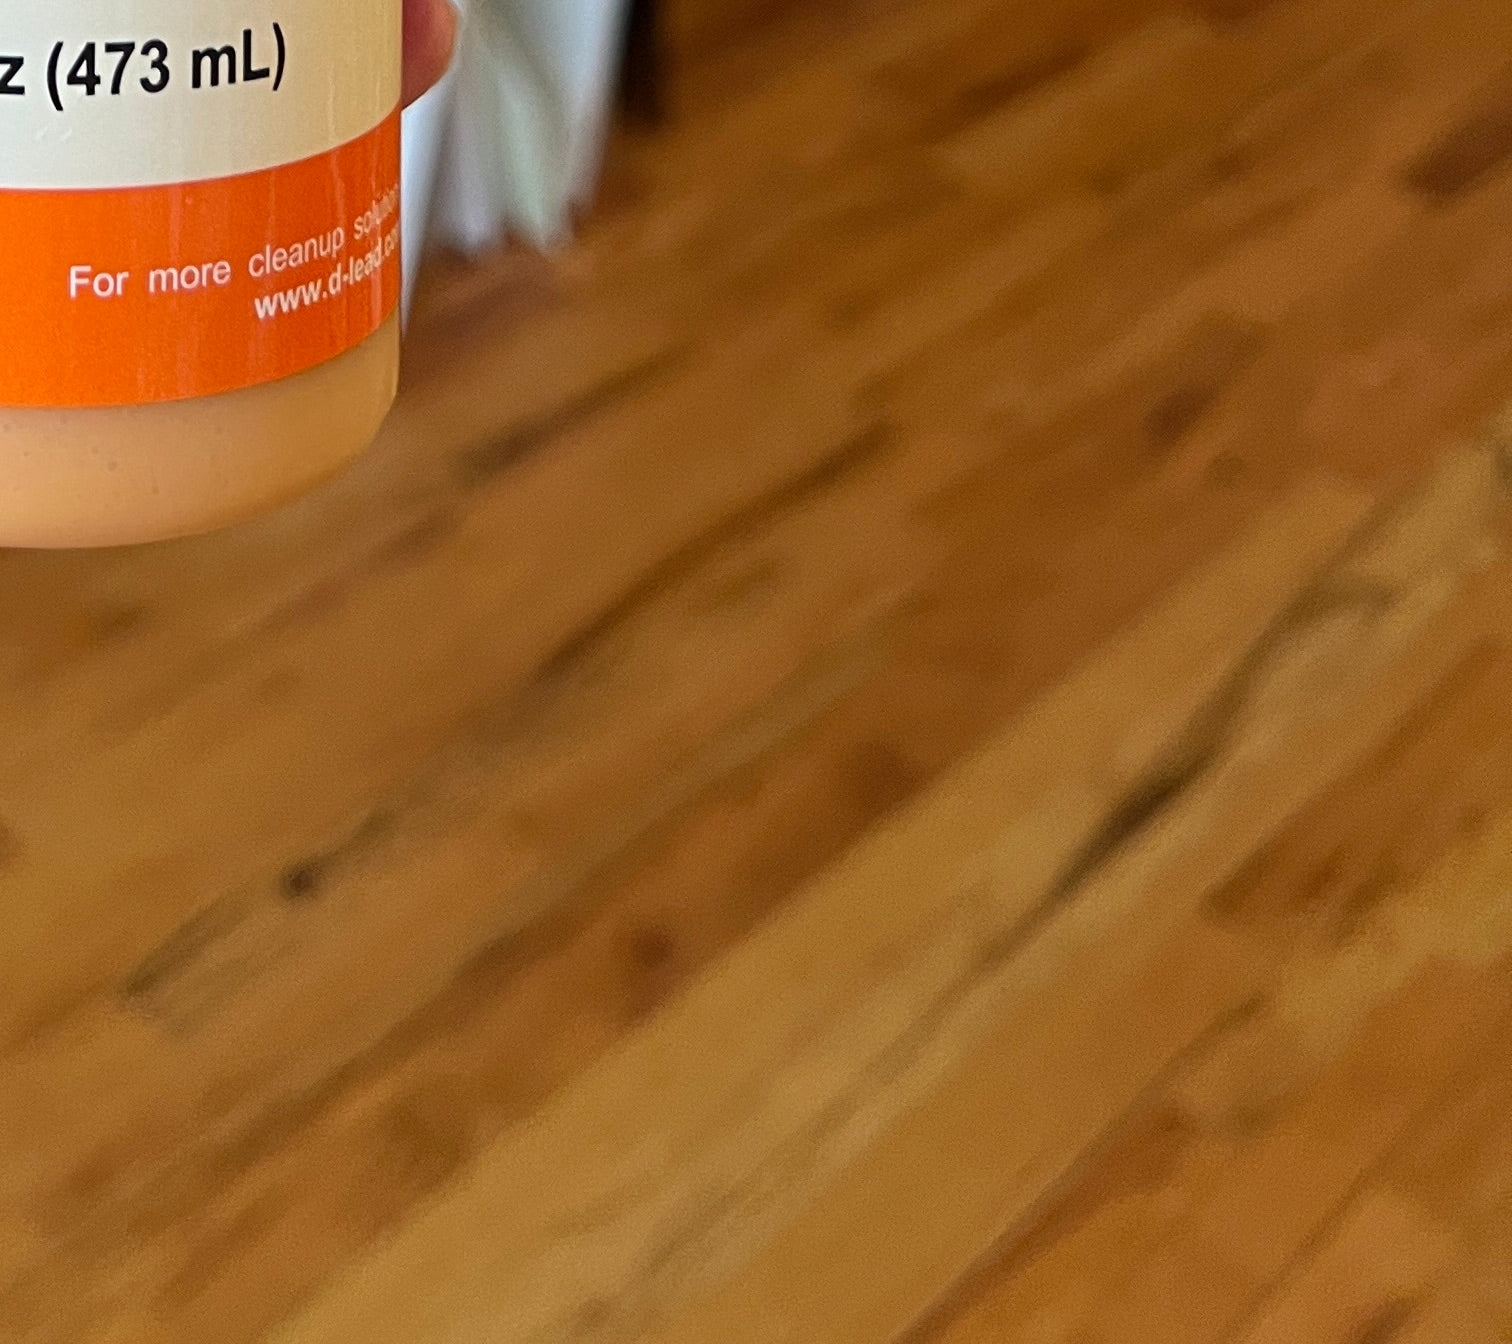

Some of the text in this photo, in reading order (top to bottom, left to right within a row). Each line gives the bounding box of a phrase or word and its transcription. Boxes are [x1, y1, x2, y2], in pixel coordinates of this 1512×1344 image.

[46, 40, 170, 112] (473
[191, 22, 288, 91] mL)
[69, 226, 345, 298] For more cleanup
